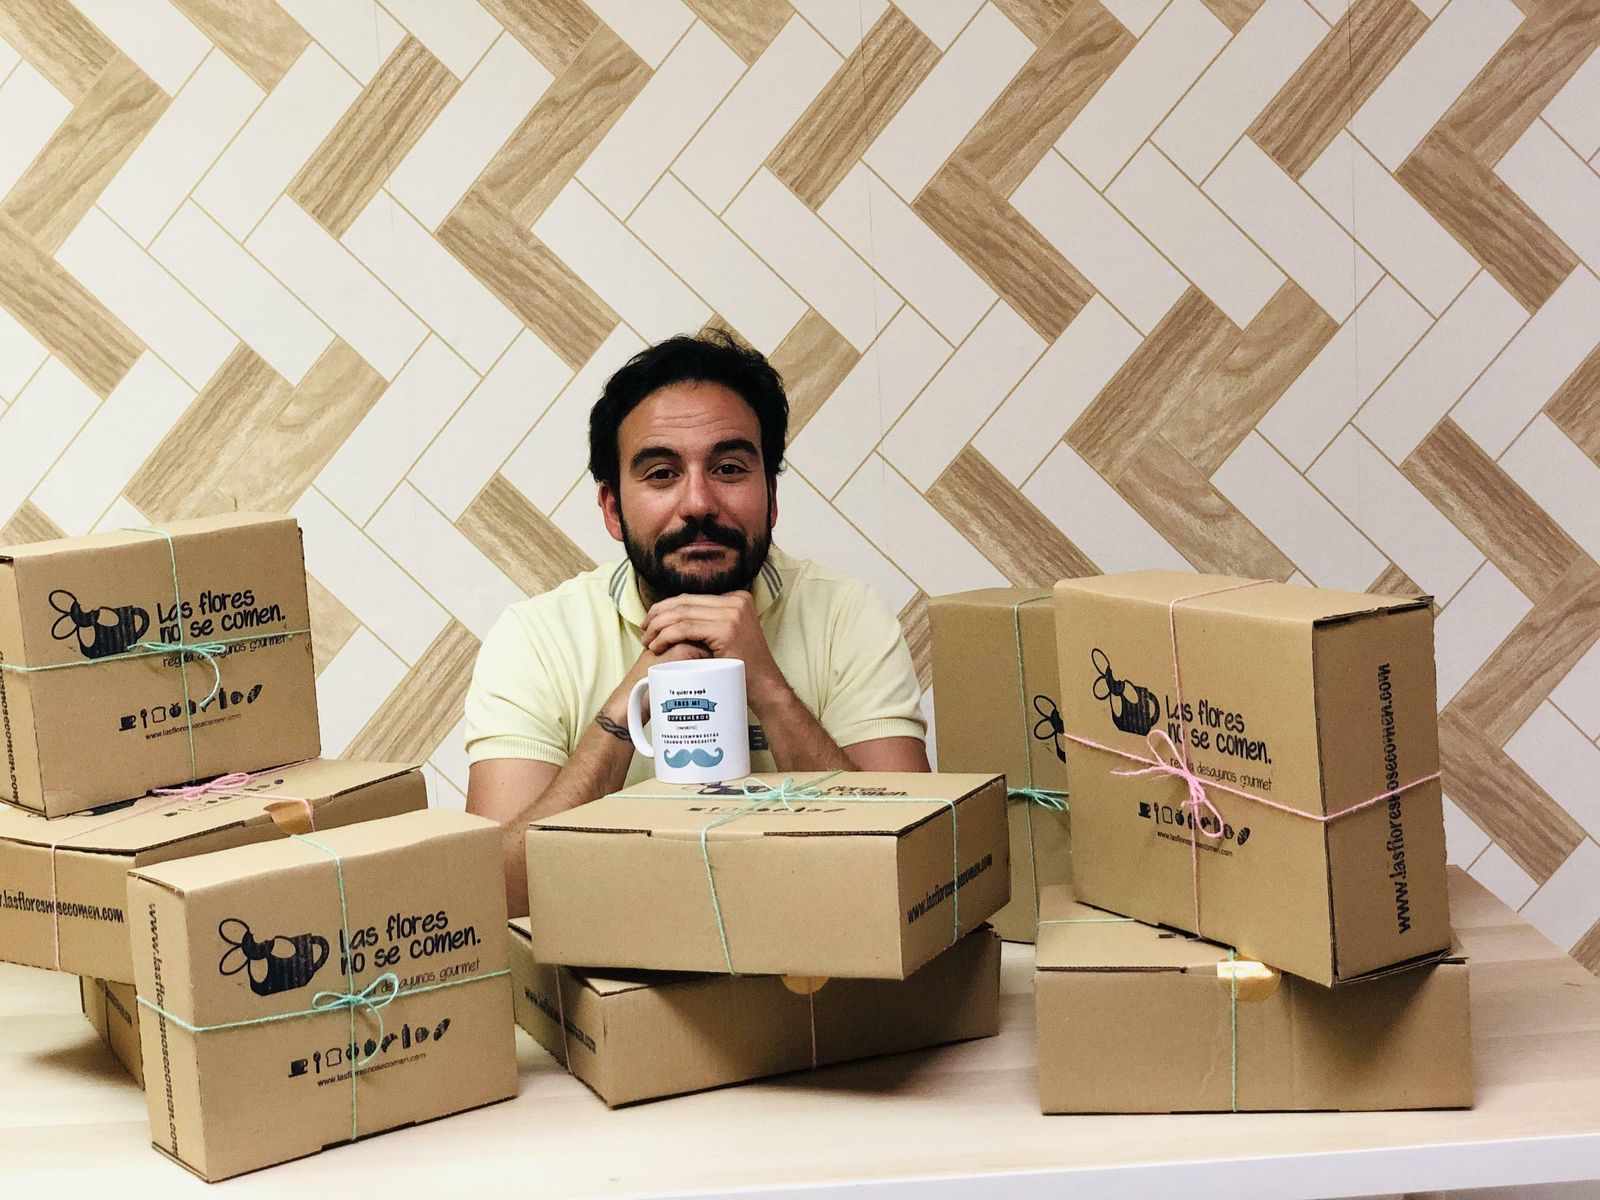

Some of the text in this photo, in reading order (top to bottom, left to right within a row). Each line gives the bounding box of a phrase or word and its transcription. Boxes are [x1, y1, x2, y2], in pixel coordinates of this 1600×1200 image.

[157, 590, 256, 625] Las flores
[160, 604, 287, 644] no se comen.
[163, 652, 194, 668] regla
[145, 713, 242, 740] www.lasfloresosecomen.com
[1165, 694, 1245, 734] Las flores
[1191, 728, 1211, 750] se
[1215, 733, 1272, 764] comen.
[1196, 761, 1237, 783] desayunos
[1240, 775, 1272, 792] gourmet
[1157, 831, 1233, 856] www.lasfloresosecomen.com
[907, 853, 993, 925] www.lasfloressecomen.com
[339, 911, 449, 953] Las flores
[341, 926, 482, 976] no se comen.
[381, 970, 436, 993] deayunos
[439, 957, 481, 980] gourmet
[317, 1052, 427, 1087] www.lasflresnosecomen.com
